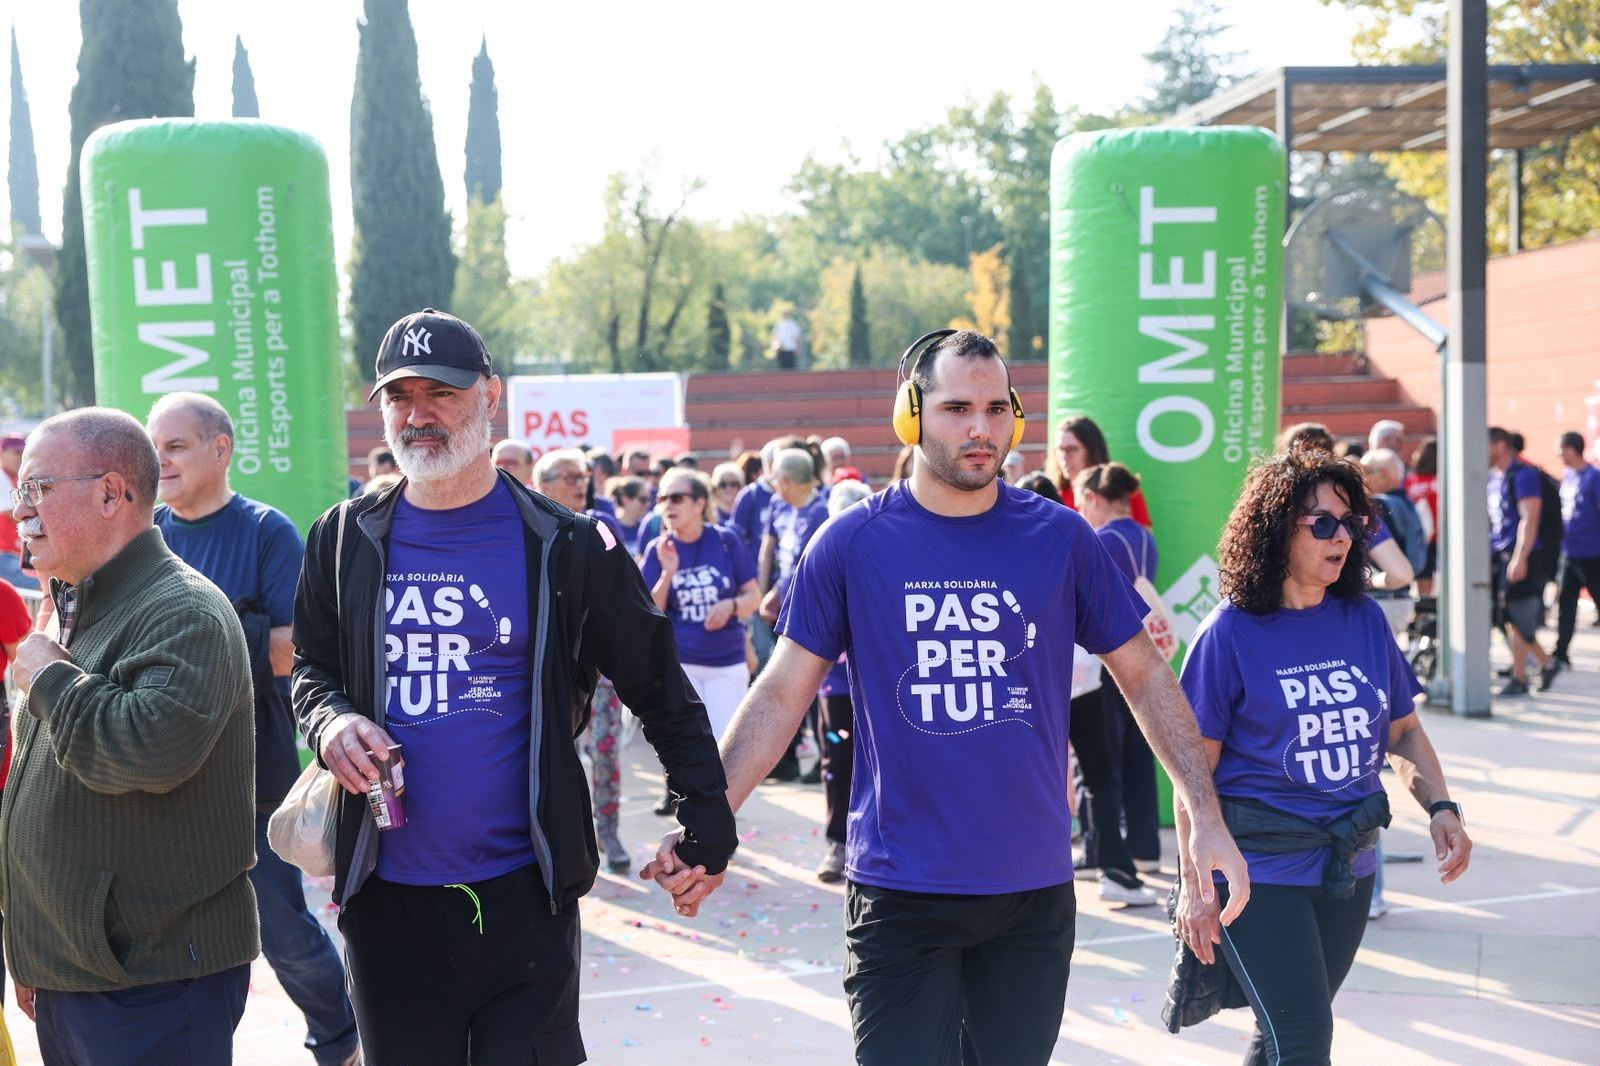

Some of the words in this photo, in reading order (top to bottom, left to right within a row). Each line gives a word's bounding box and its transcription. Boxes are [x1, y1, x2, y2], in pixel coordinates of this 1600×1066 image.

[254, 185, 280, 283] Tothom
[1250, 185, 1268, 278] Tothom
[128, 187, 219, 394] MET
[263, 289, 281, 304] a
[1254, 285, 1266, 298] a
[223, 258, 255, 381] Municipal
[264, 308, 289, 351] per
[1136, 185, 1217, 463] OMET
[1225, 256, 1249, 373] Municipal
[1253, 305, 1267, 344] per
[402, 326, 433, 357] NY
[235, 386, 262, 475] Officina
[266, 356, 293, 473] d'Esports
[523, 410, 589, 438] PAS
[1222, 378, 1245, 463] Officina
[386, 573, 404, 582] RXA
[407, 572, 465, 582] SOLIDÀRIA
[671, 569, 713, 590] PAS
[676, 585, 719, 606] PER
[905, 581, 941, 590] MARXA
[943, 579, 998, 589] SOLIDÀRIA
[904, 592, 1000, 632] PAS
[916, 640, 1008, 678] PER
[1276, 665, 1304, 676] MARXA
[1304, 659, 1347, 672] SOLIDÀRIA
[911, 681, 994, 722] TU!
[1279, 670, 1358, 709] PAS
[1297, 706, 1372, 747] PER
[1295, 744, 1361, 784] TU!
